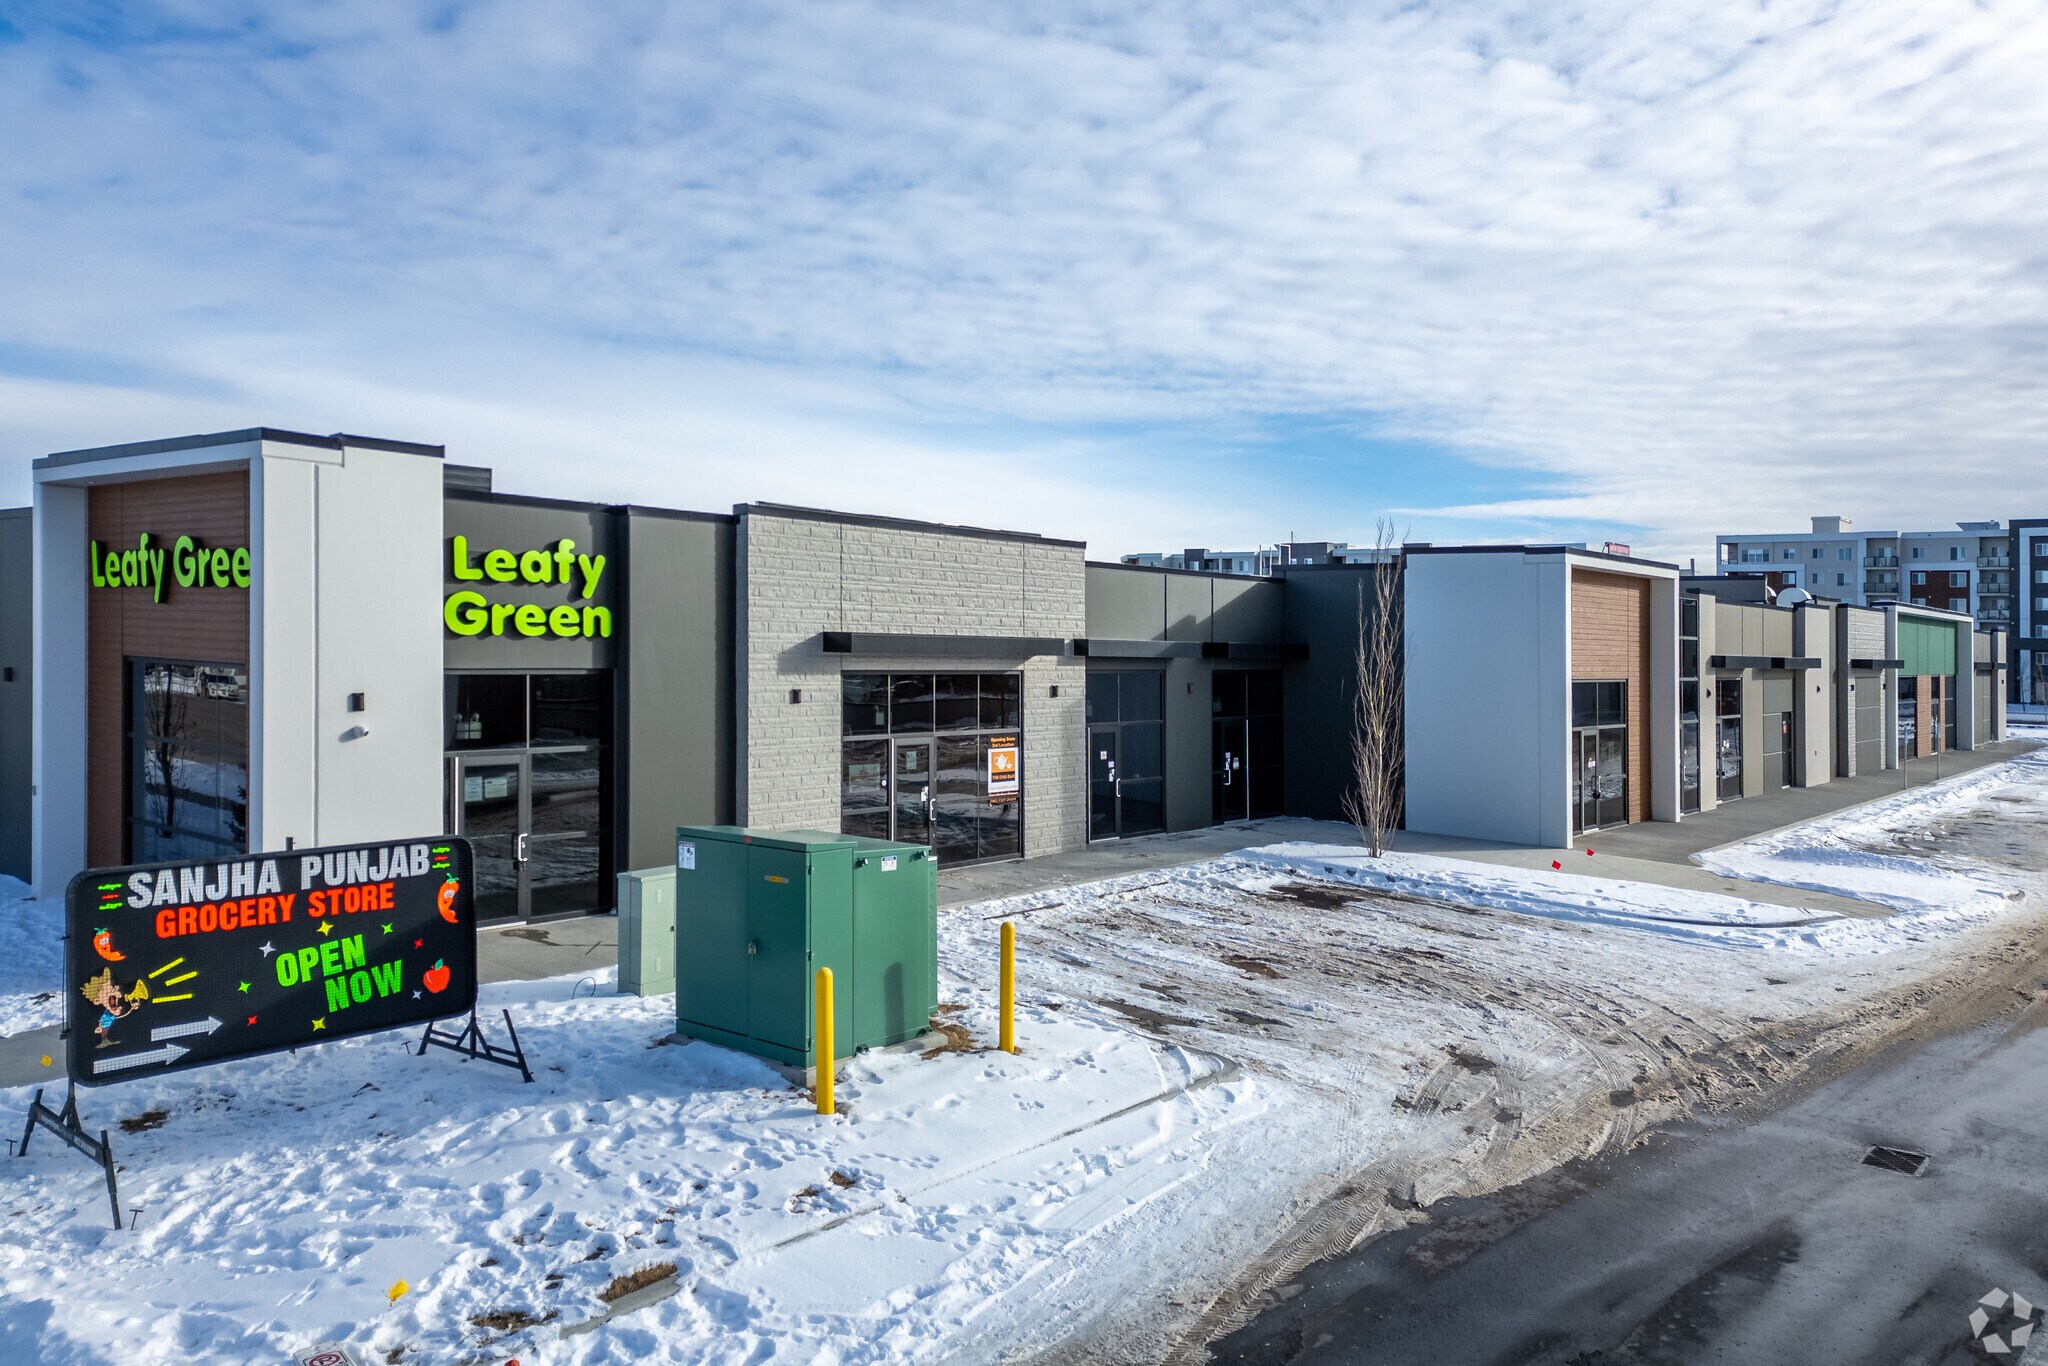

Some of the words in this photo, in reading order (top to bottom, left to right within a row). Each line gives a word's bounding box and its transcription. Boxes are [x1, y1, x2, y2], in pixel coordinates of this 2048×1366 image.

[91, 532, 165, 604] Leafy
[173, 534, 250, 588] Gree
[453, 535, 606, 600] Leafy
[444, 590, 612, 638] Green
[127, 859, 281, 909] SANJHA
[301, 843, 430, 891] PUNJAB
[155, 893, 297, 939] GROCERY
[308, 881, 395, 918] STORE
[275, 934, 367, 987] OPEN
[324, 959, 403, 1013] NOW
